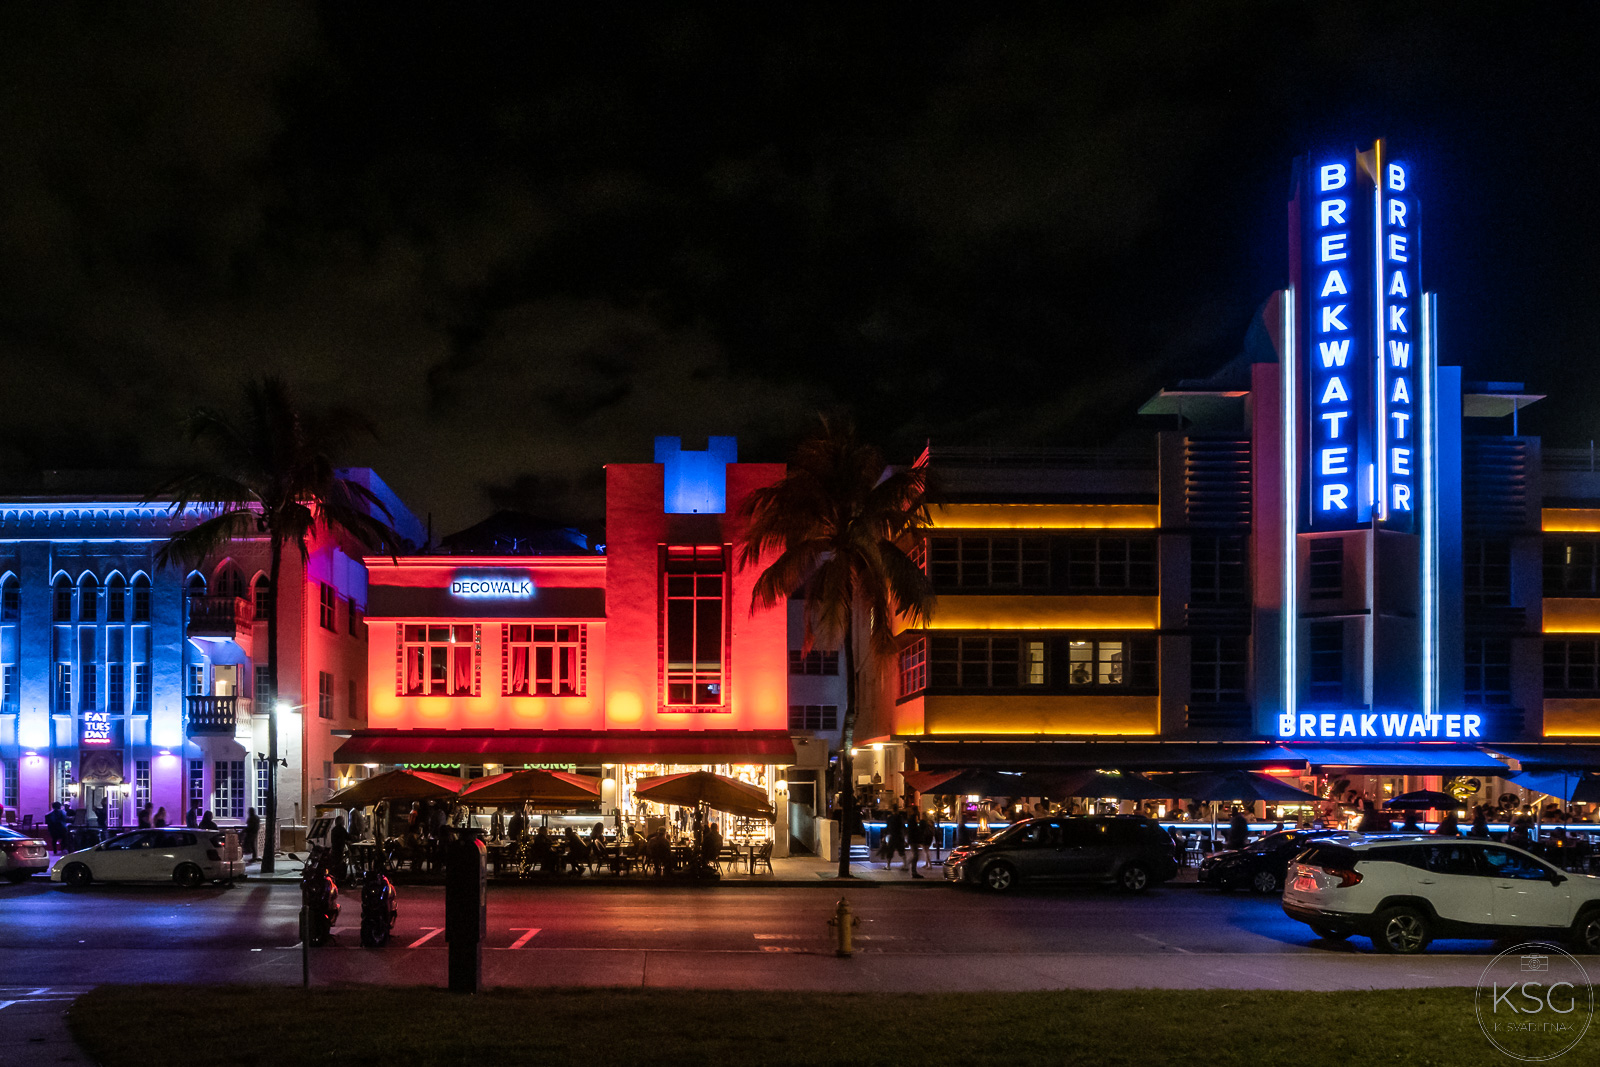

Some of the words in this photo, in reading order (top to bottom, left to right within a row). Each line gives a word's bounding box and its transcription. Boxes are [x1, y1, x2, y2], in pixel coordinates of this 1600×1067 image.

[1318, 163, 1350, 511] BREAKWATER
[1388, 163, 1411, 511] BREAKWATER
[452, 581, 530, 594] DECOWALK
[84, 711, 111, 722] FAT
[85, 722, 111, 731] TUES
[1279, 713, 1482, 738] BREAKWATER
[84, 730, 110, 739] DAY
